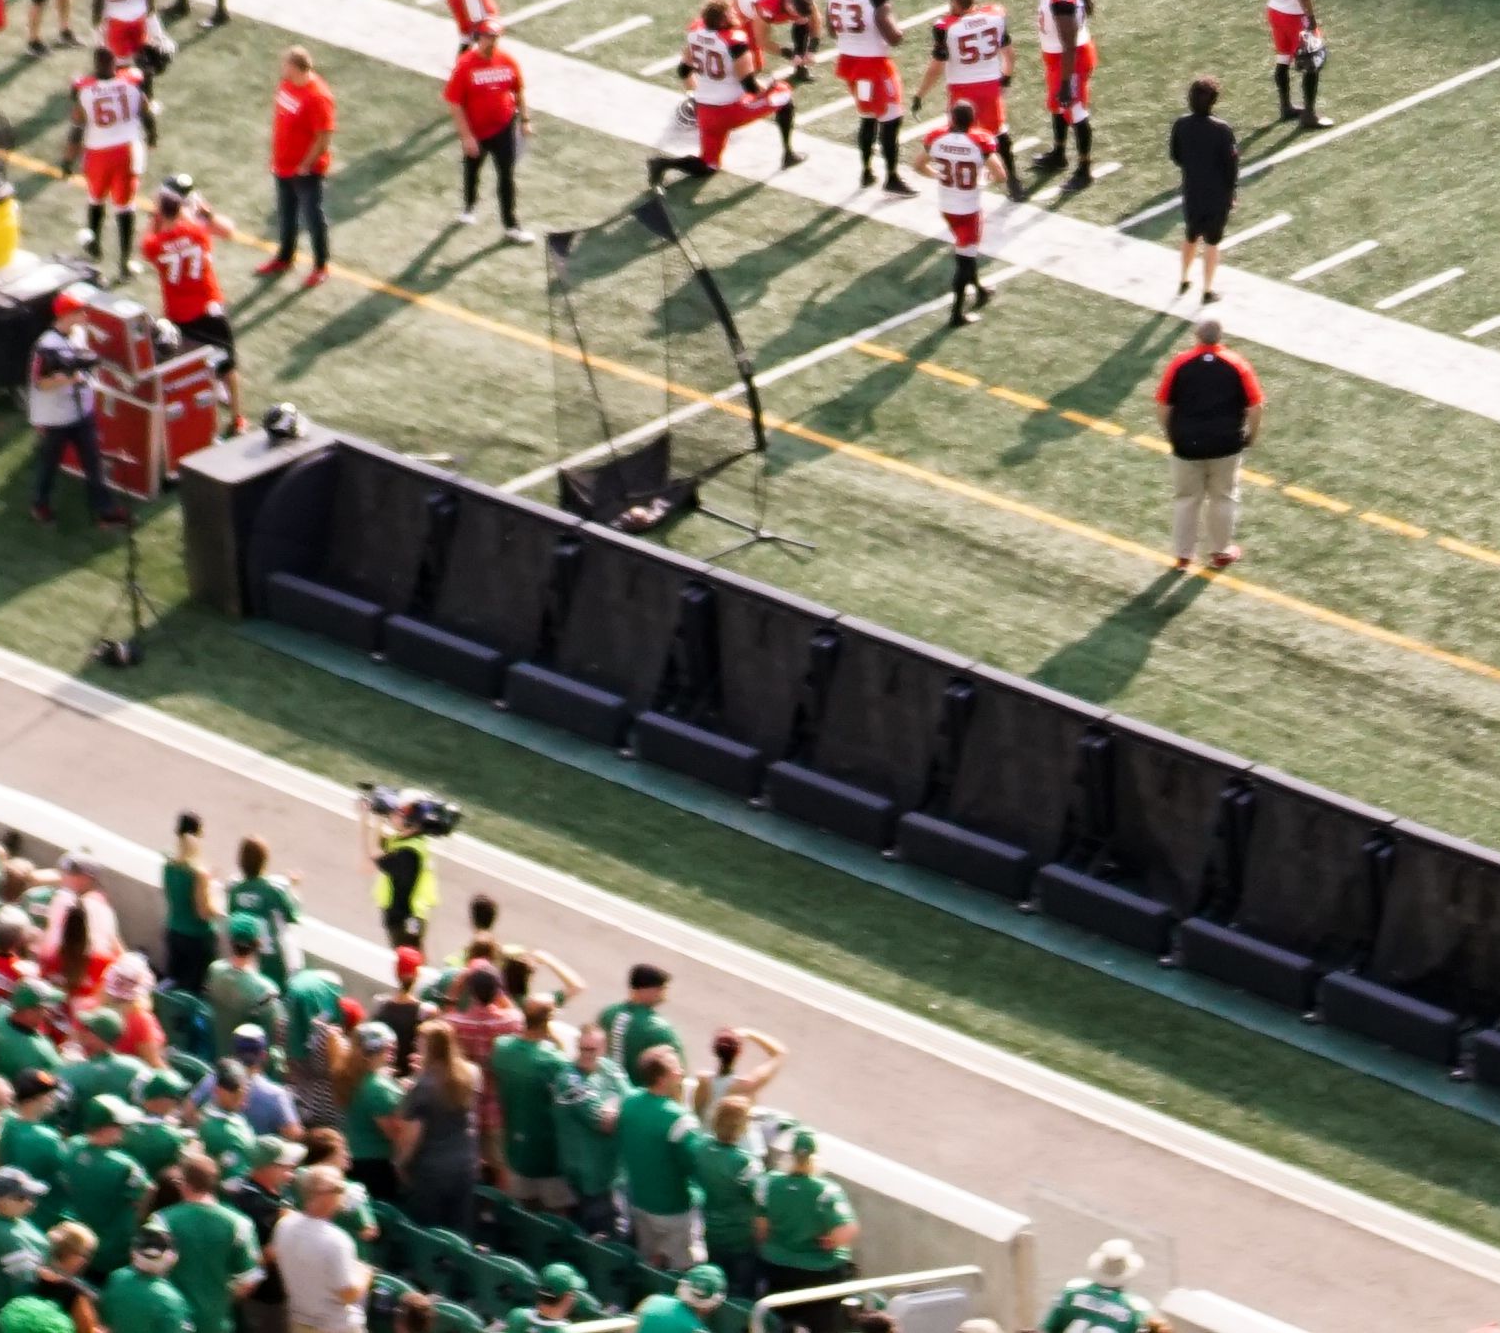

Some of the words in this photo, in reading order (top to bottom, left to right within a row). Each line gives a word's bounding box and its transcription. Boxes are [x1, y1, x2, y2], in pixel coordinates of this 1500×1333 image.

[692, 42, 726, 80] 50
[960, 25, 999, 64] 53
[91, 94, 130, 128] 61
[935, 158, 979, 192] 30
[159, 247, 202, 284] 77
